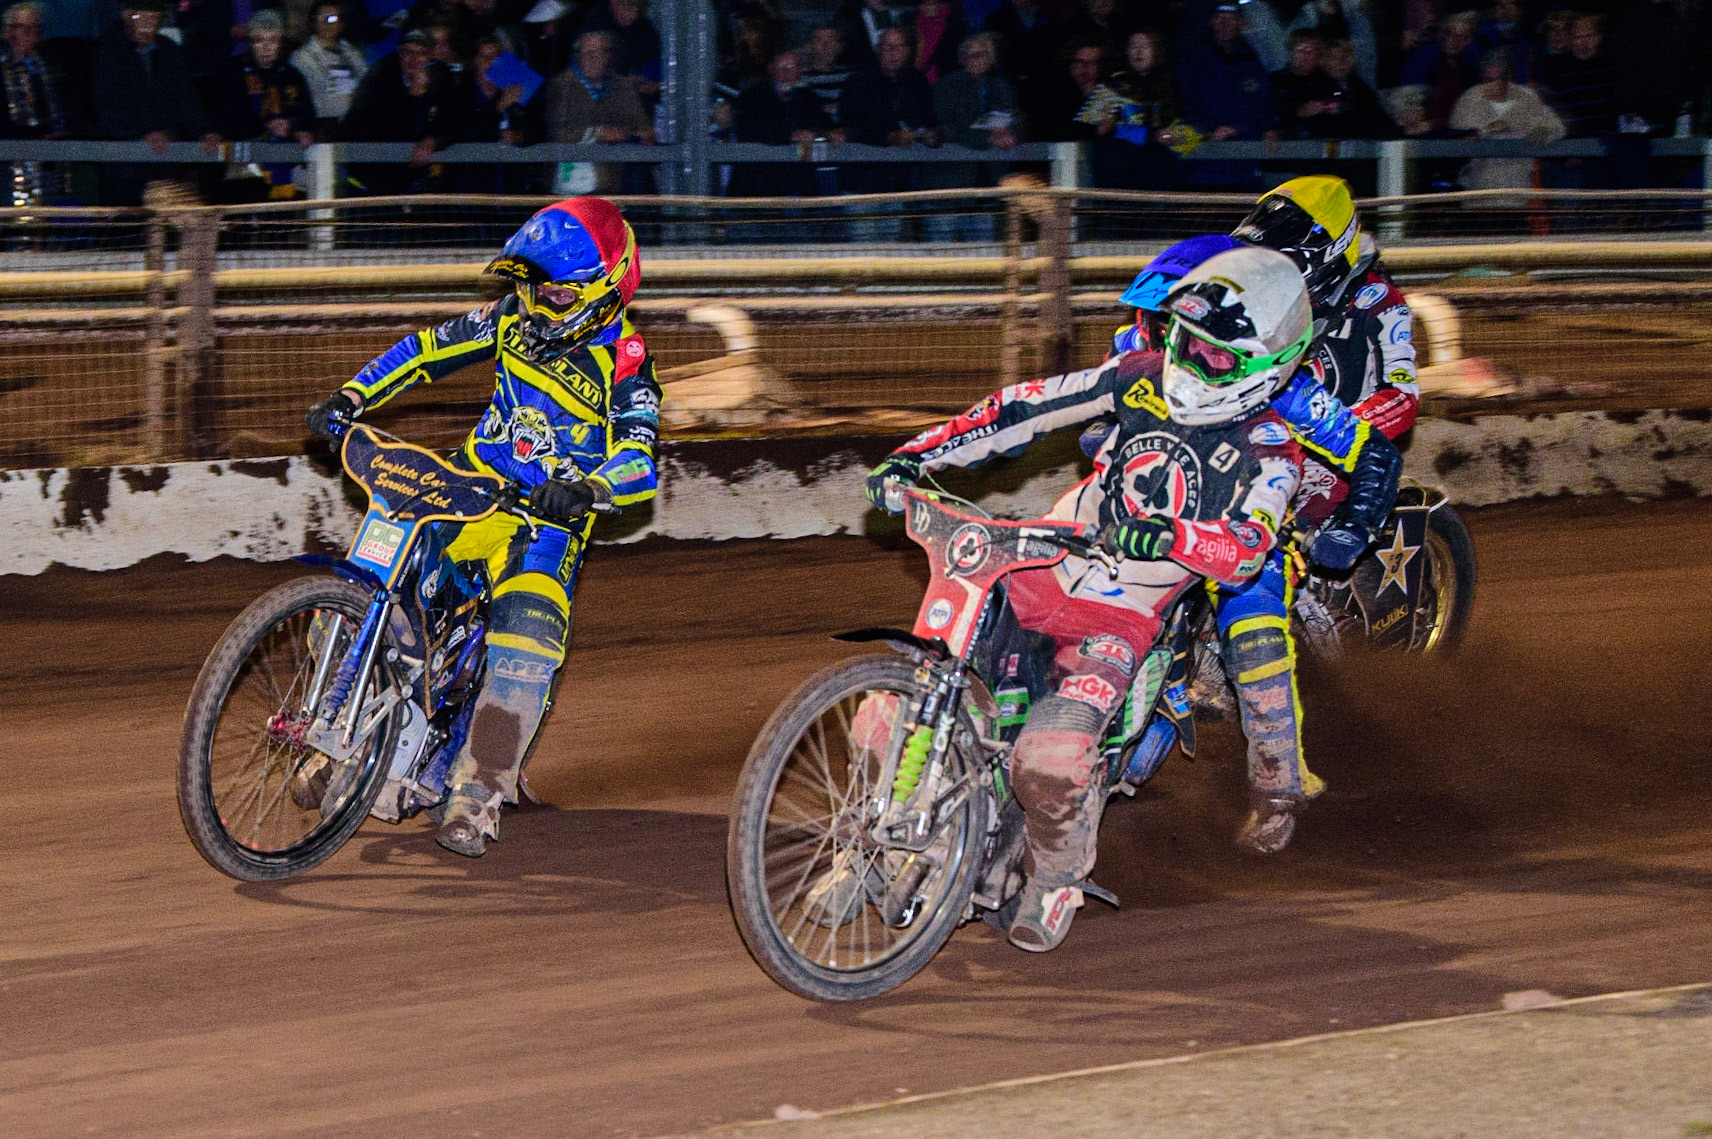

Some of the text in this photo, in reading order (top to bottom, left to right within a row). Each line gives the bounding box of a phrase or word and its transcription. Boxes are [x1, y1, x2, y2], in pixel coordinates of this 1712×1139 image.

[569, 423, 590, 445] 4
[370, 454, 447, 489] Complete Car
[1217, 448, 1234, 469] 4
[1125, 438, 1162, 458] BELLE
[1185, 470, 1197, 508] ACES
[374, 472, 452, 509] Services Ltd
[367, 540, 396, 555] GROUP
[1026, 540, 1058, 558] agilia
[1197, 537, 1238, 563] agilia
[1063, 677, 1113, 706] NGK
